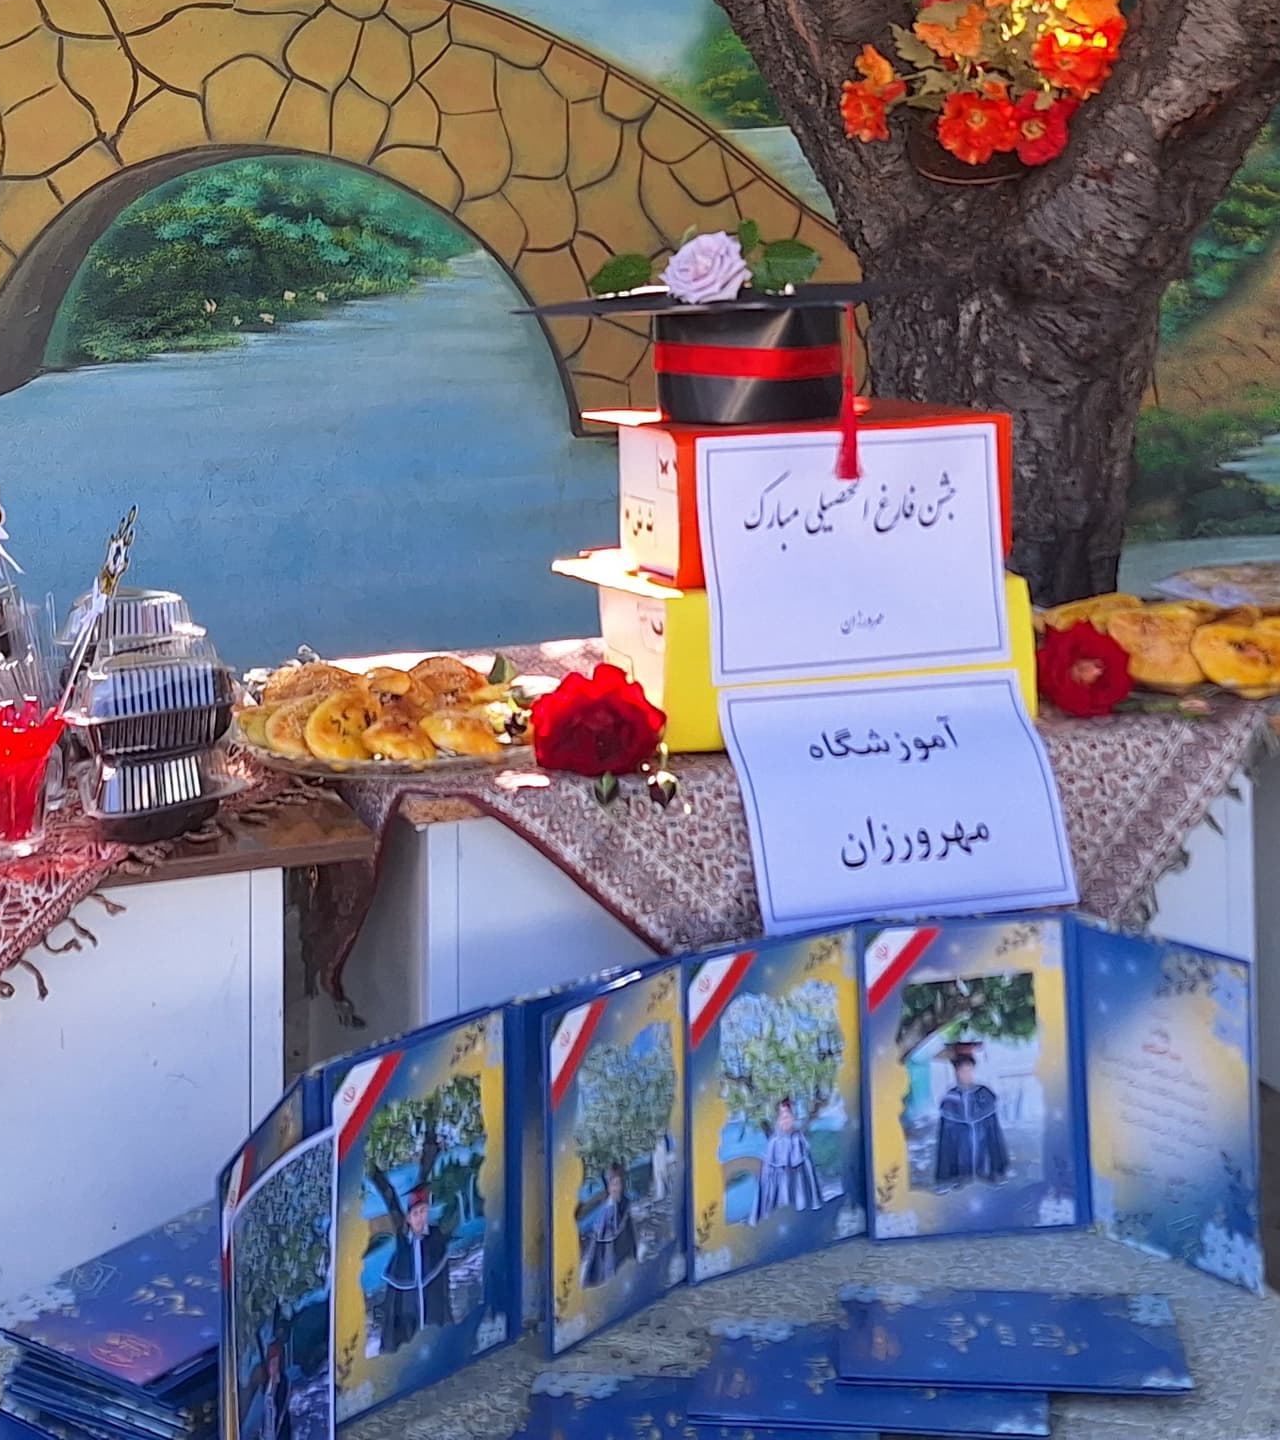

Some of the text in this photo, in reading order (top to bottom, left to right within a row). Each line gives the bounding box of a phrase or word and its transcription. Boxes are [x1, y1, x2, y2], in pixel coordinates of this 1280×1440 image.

[743, 469, 800, 553] مبارک
[873, 483, 918, 534] فارغ
[918, 471, 958, 527] جشن
[809, 715, 959, 763] آموزشگاه
[840, 815, 990, 868] مهرورزان
